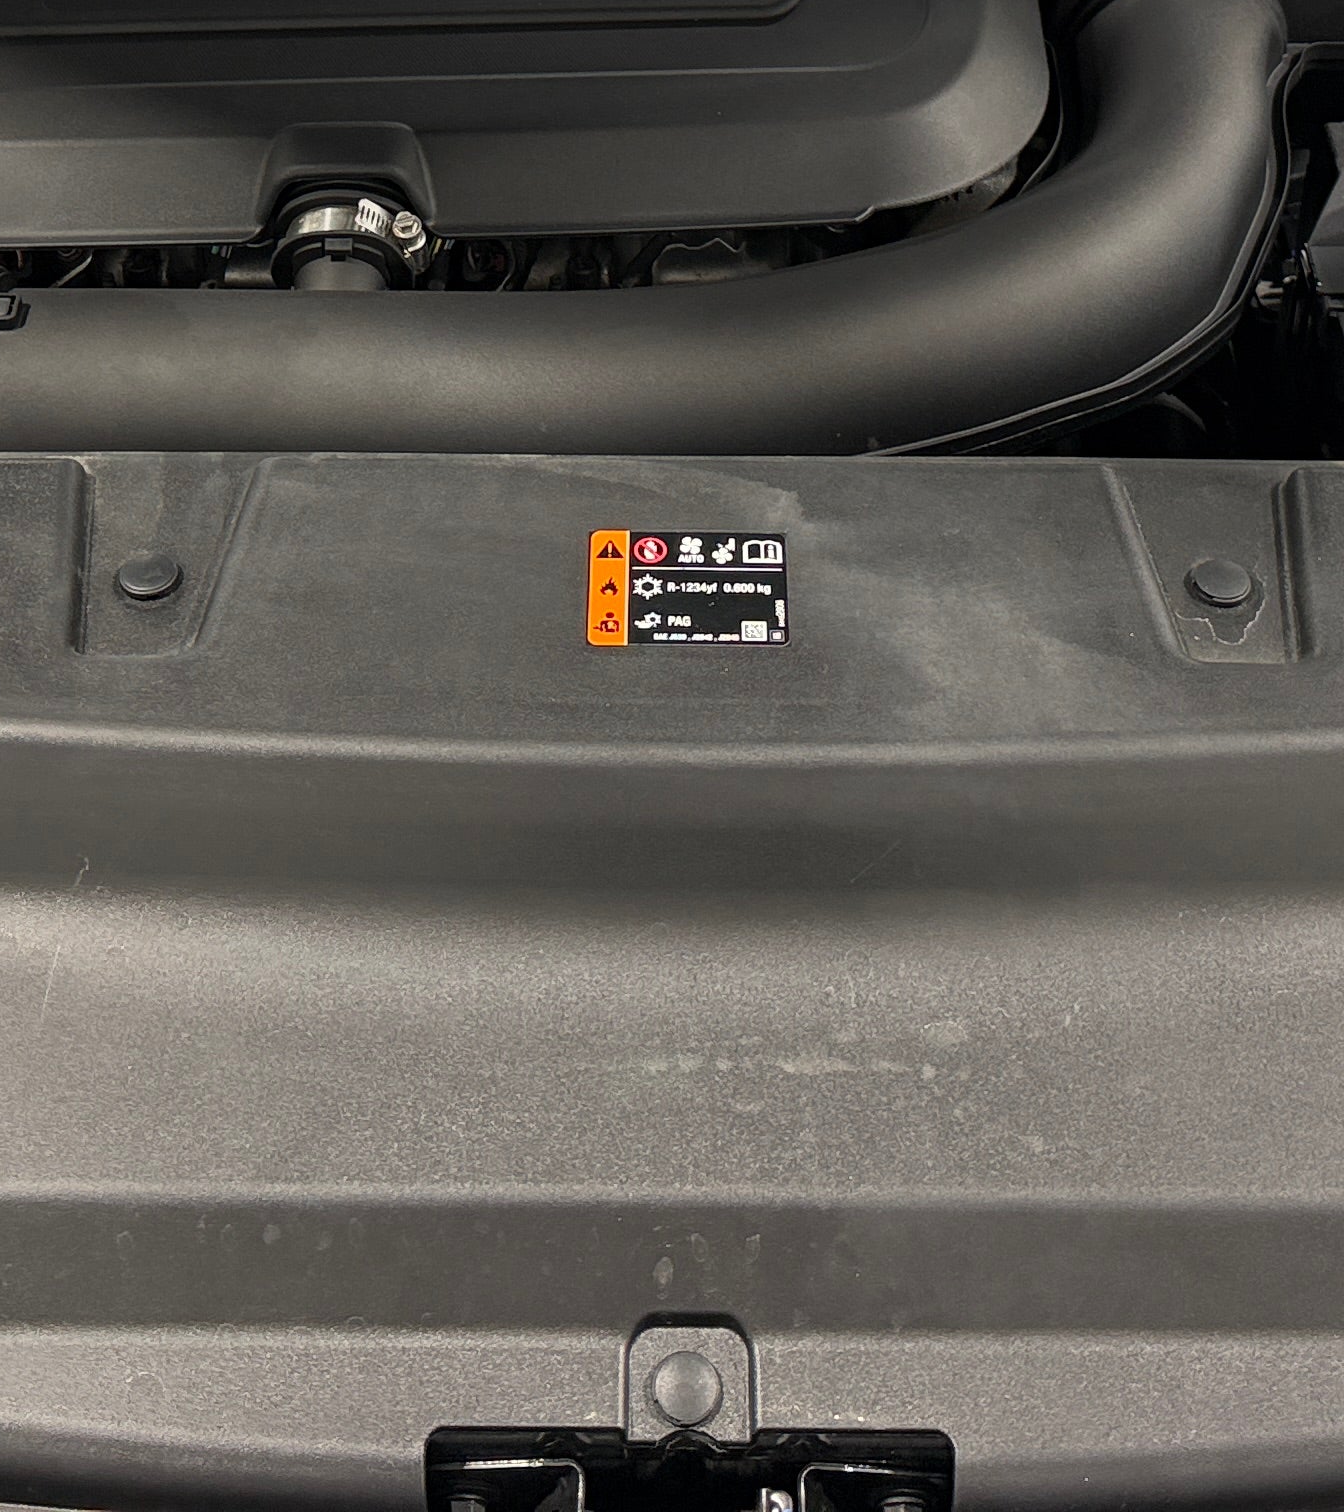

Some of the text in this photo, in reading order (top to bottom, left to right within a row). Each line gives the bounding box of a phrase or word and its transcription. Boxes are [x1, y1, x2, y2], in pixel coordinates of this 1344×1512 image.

[678, 554, 704, 563] AUTO
[667, 582, 717, 594] R-1234yf
[757, 583, 771, 595] kg
[668, 616, 691, 626] PAG
